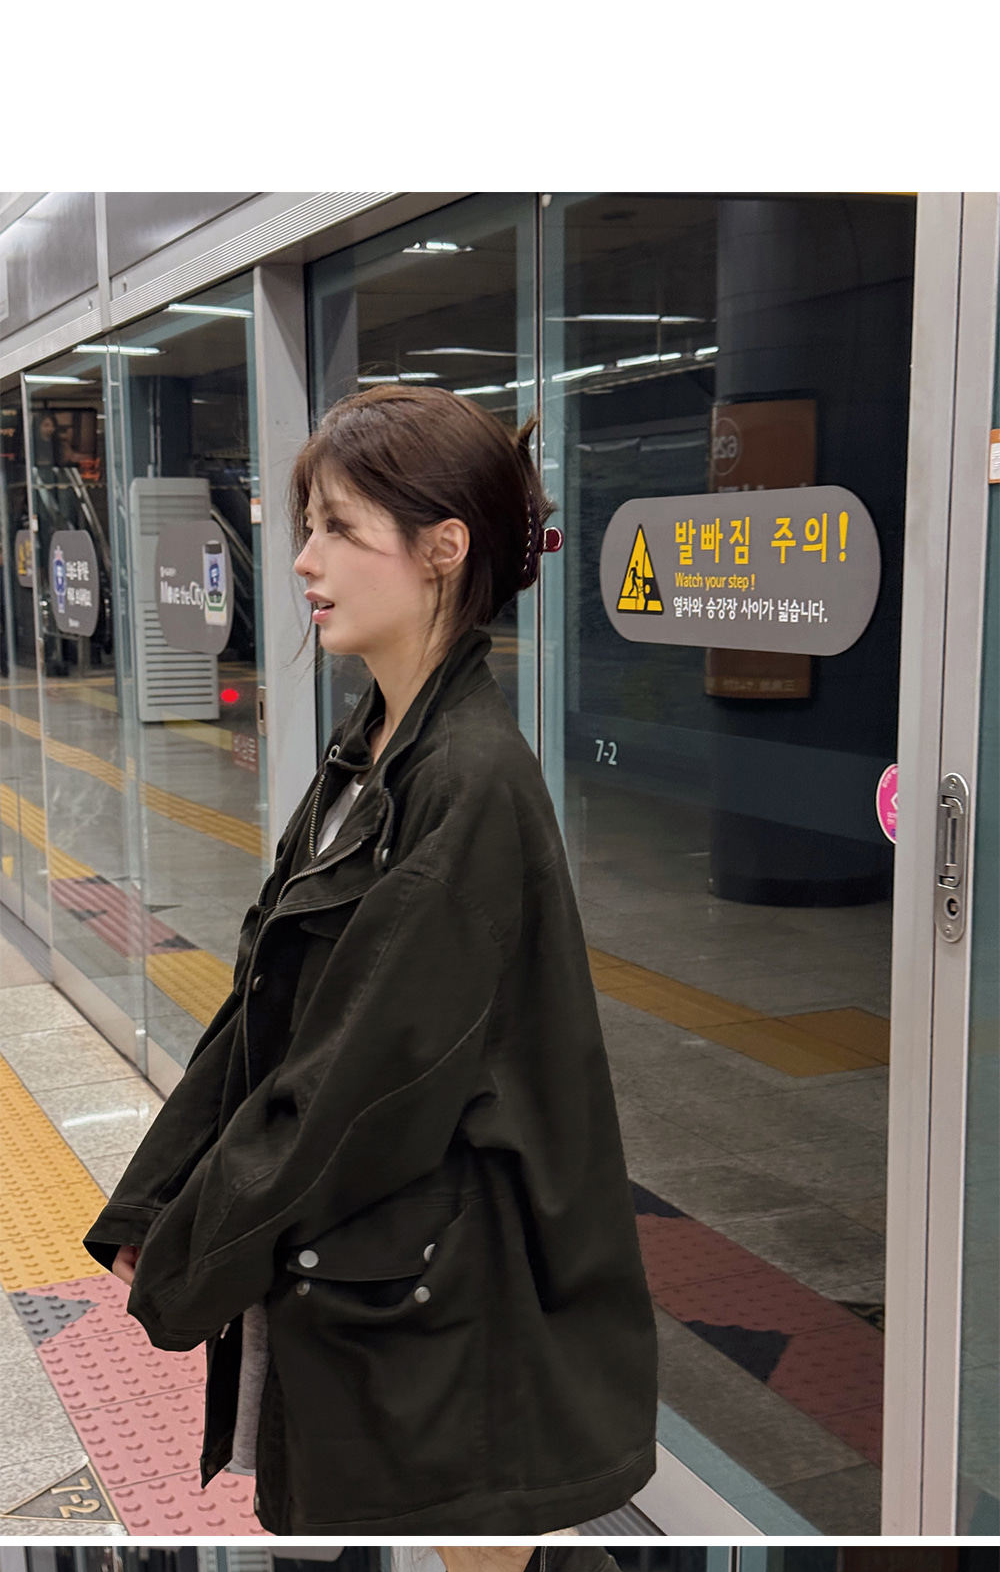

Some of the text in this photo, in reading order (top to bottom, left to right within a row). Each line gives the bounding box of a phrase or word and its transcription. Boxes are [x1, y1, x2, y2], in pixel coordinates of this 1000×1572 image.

[674, 511, 849, 565] 발빠짐 주의!
[675, 572, 703, 589] Watch
[704, 575, 726, 591] your
[673, 595, 828, 624] 열차와 승강장 사이가 넓습니다.
[595, 739, 618, 766] 7-2
